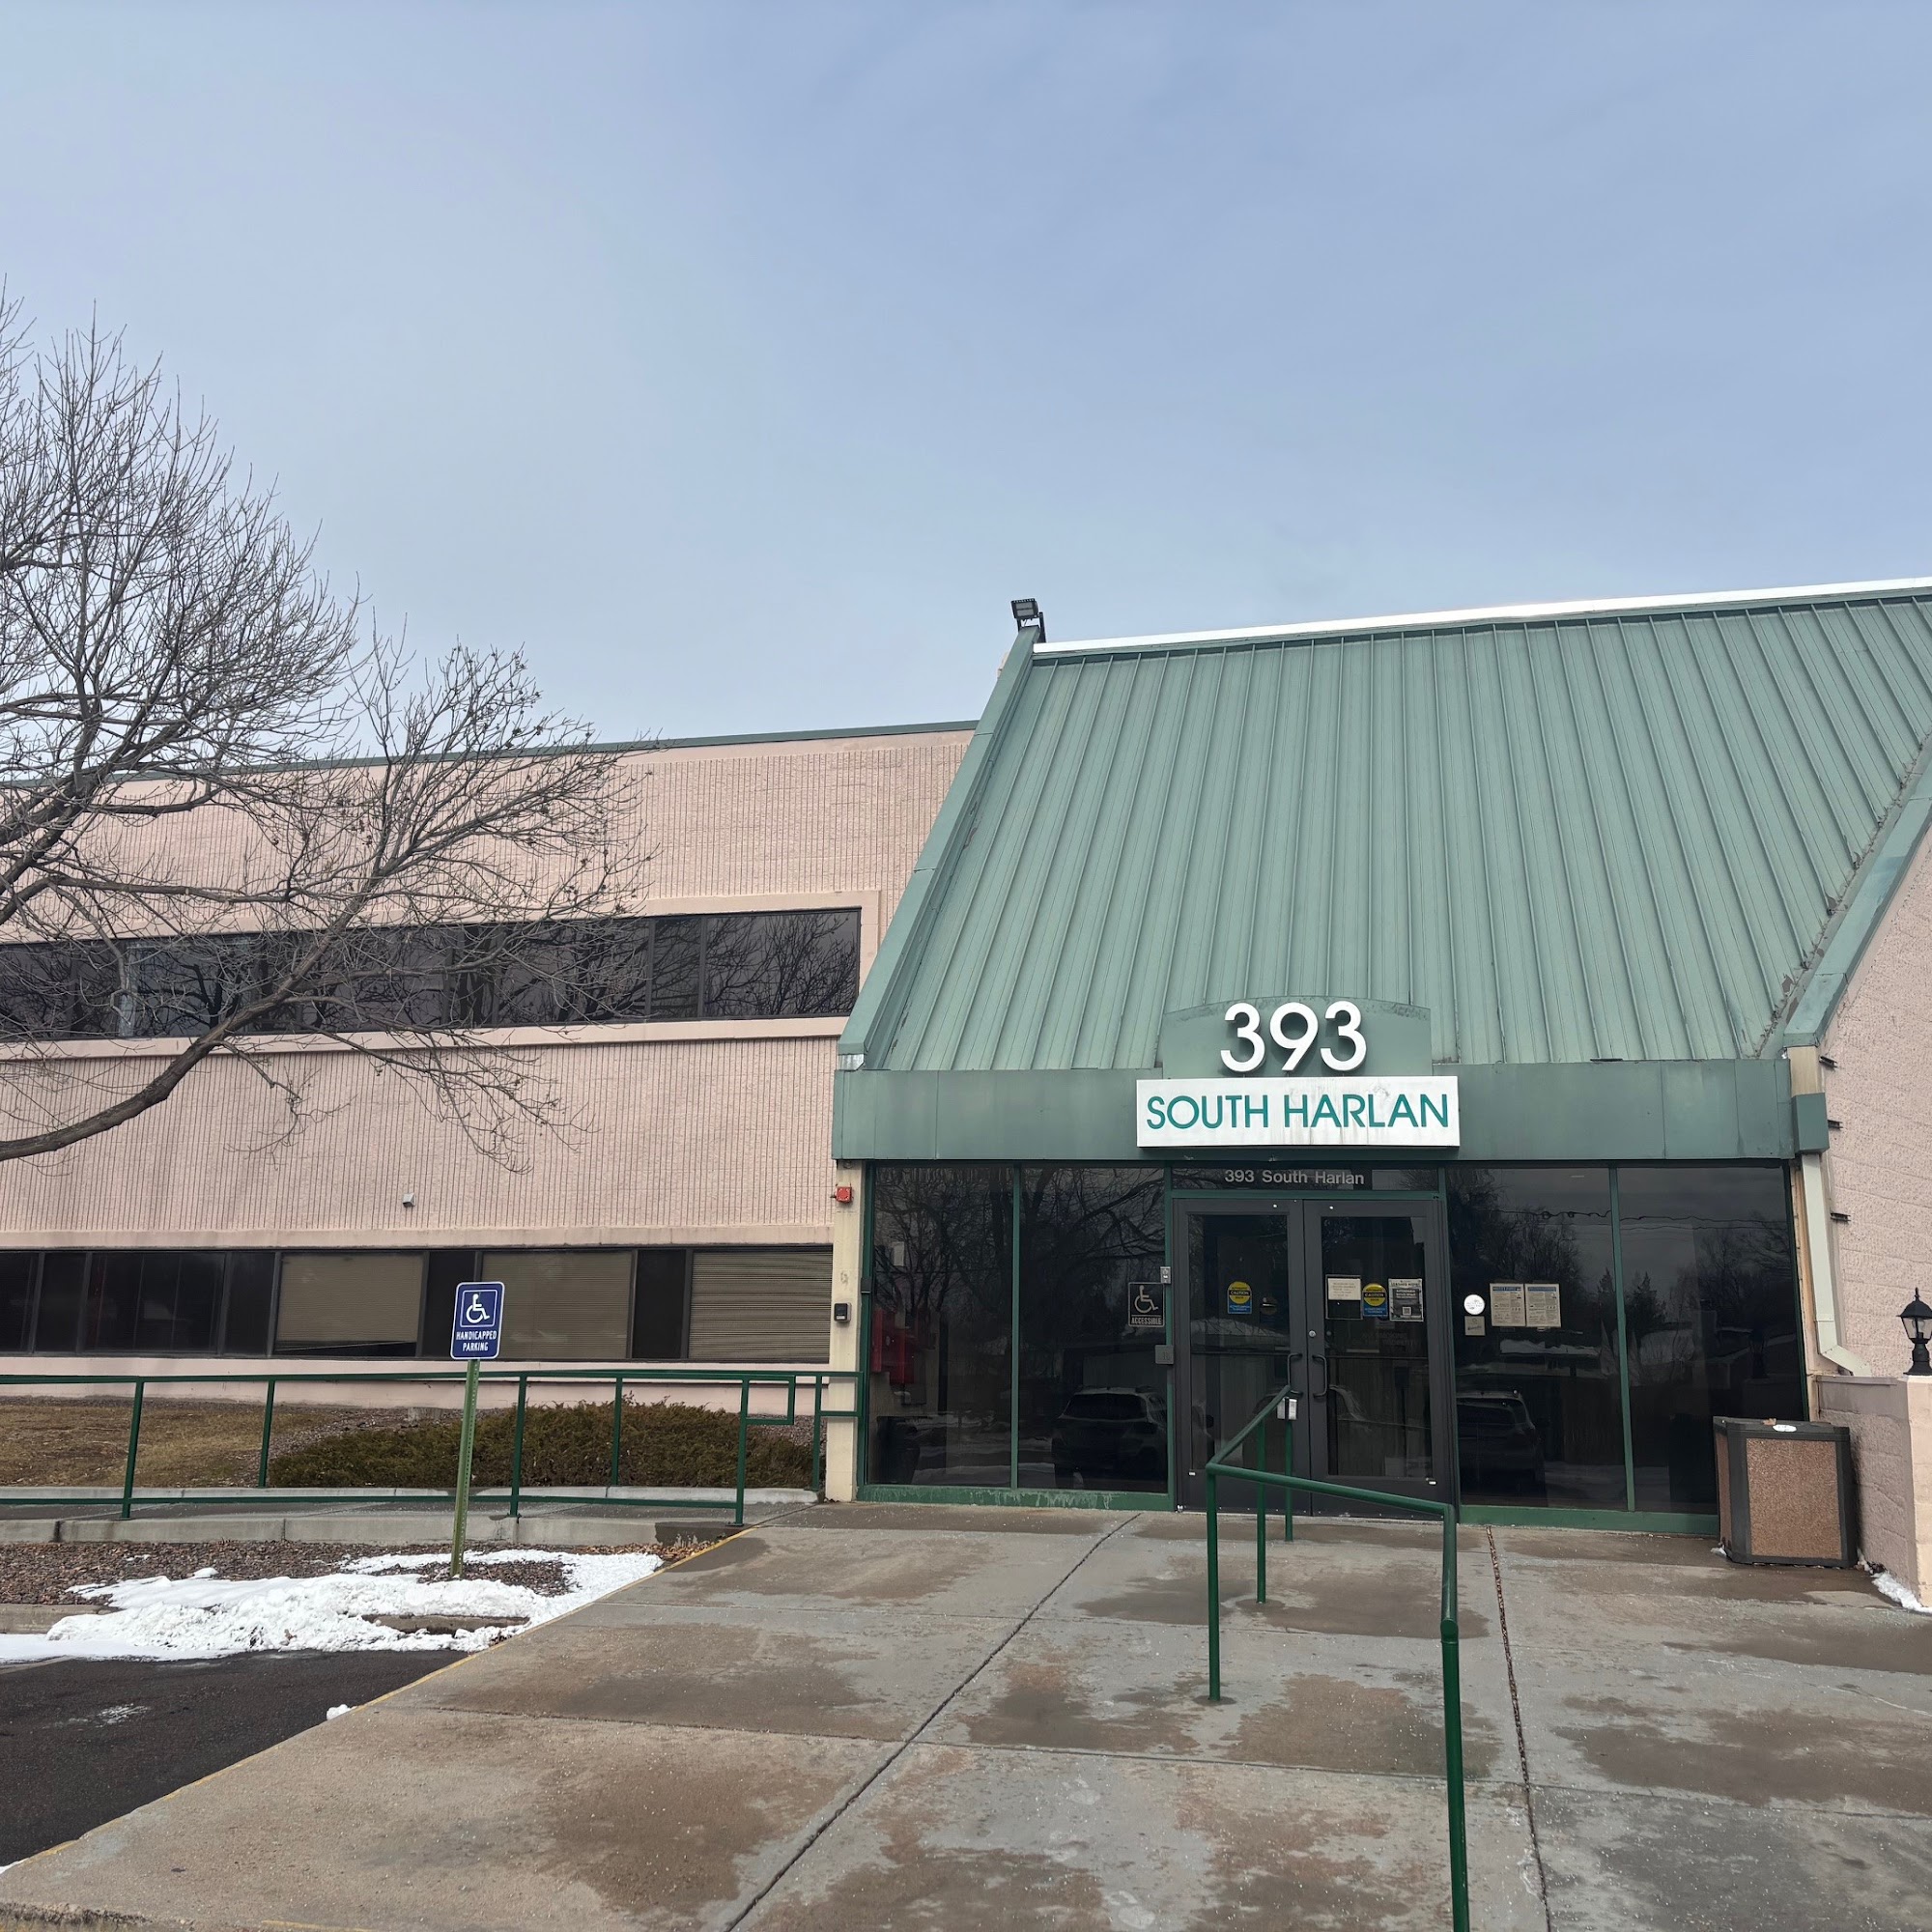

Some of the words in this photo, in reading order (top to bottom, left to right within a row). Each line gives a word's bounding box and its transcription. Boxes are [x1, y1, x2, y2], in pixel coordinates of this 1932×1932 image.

[1220, 1001, 1367, 1073] 393
[1147, 1094, 1268, 1129] SOUTH
[1284, 1094, 1449, 1128] HARLAN
[1224, 1169, 1255, 1183] 393
[1262, 1170, 1308, 1184] South
[1315, 1170, 1365, 1185] Harlan
[1131, 1317, 1161, 1325] ACCESSIBLE
[456, 1331, 497, 1340] HANDICAPPED
[463, 1342, 489, 1351] PARKING
